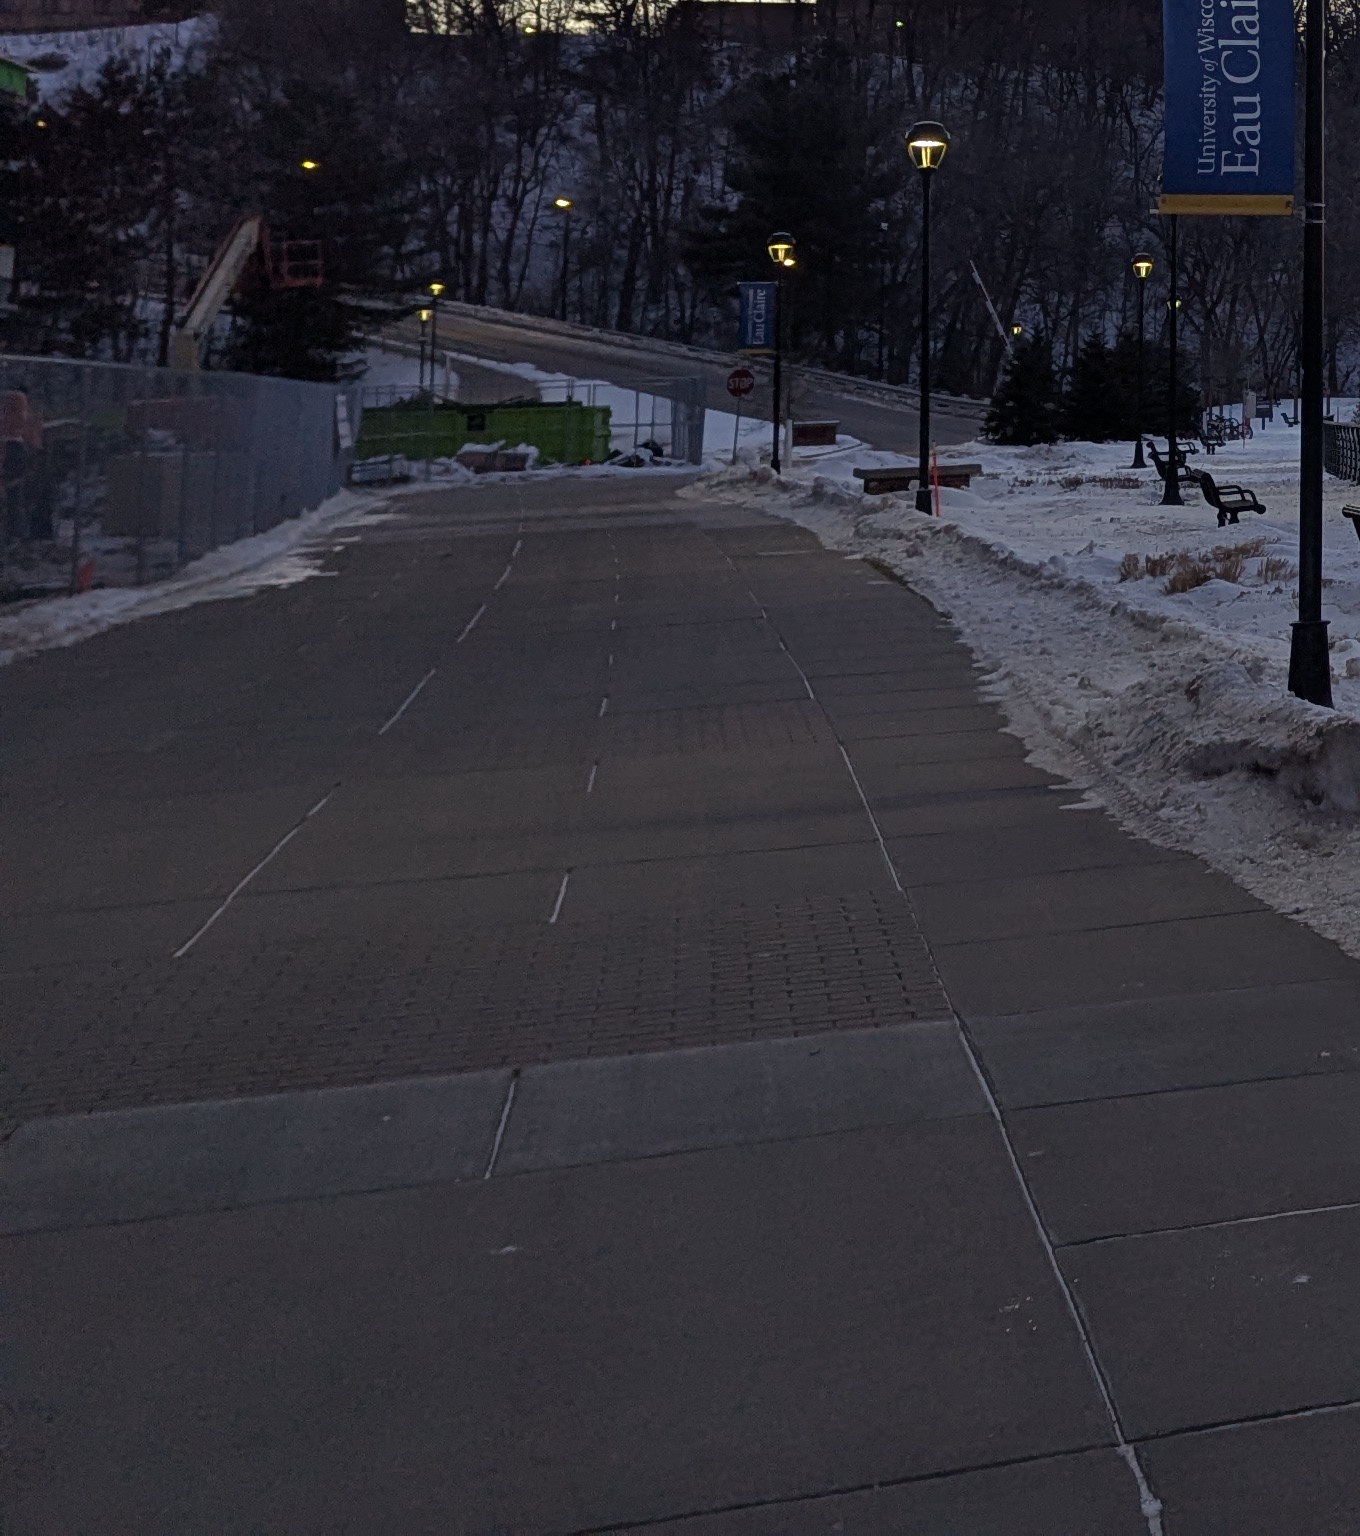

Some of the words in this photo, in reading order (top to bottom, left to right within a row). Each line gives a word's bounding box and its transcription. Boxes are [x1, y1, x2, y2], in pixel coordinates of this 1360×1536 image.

[1203, 55, 1218, 74] of
[1197, 75, 1221, 175] University
[1220, 92, 1261, 177] Eau
[753, 289, 766, 323] Claire
[728, 377, 754, 390] STOP
